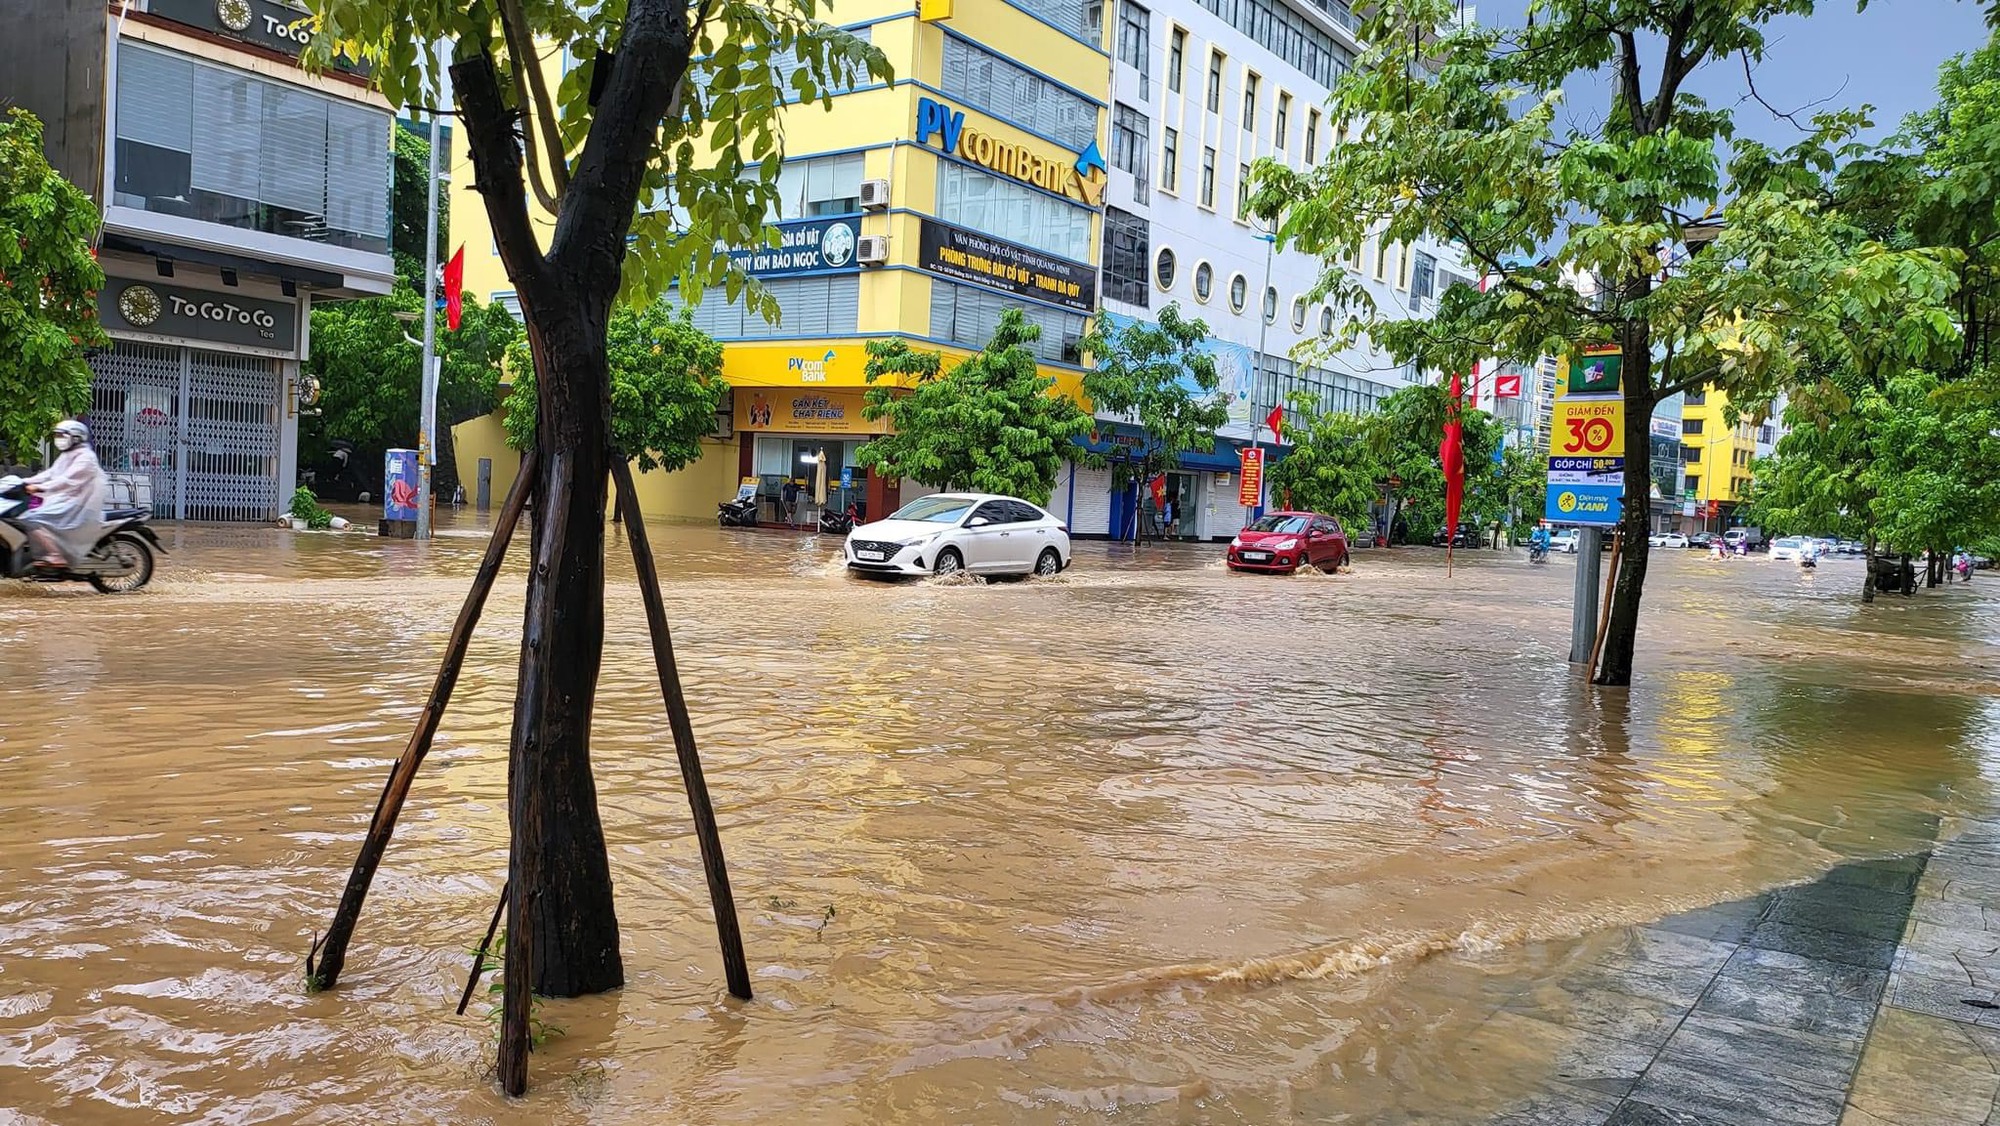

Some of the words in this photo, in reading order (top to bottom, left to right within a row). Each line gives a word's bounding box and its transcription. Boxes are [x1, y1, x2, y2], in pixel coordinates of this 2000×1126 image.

[916, 96, 1076, 197] PVcomBank
[806, 228, 820, 248] VẬT
[753, 255, 770, 271] KIM
[772, 249, 791, 270] BẢO
[793, 250, 819, 270] NGỌC
[969, 237, 989, 253] PHÒNG
[1055, 265, 1070, 276] NINH
[940, 245, 966, 267] PHÒNG
[992, 260, 1007, 278] BÀY
[1017, 266, 1030, 286] VẬT
[1035, 273, 1058, 292] TRANH
[169, 295, 275, 328] ToCoToCo
[259, 329, 275, 339] Tea
[788, 357, 824, 371] PVcom
[802, 370, 826, 382] Bank
[1594, 404, 1615, 416] ĐẾN
[1554, 457, 1575, 469] GÓP
[1576, 501, 1609, 512] XANH
